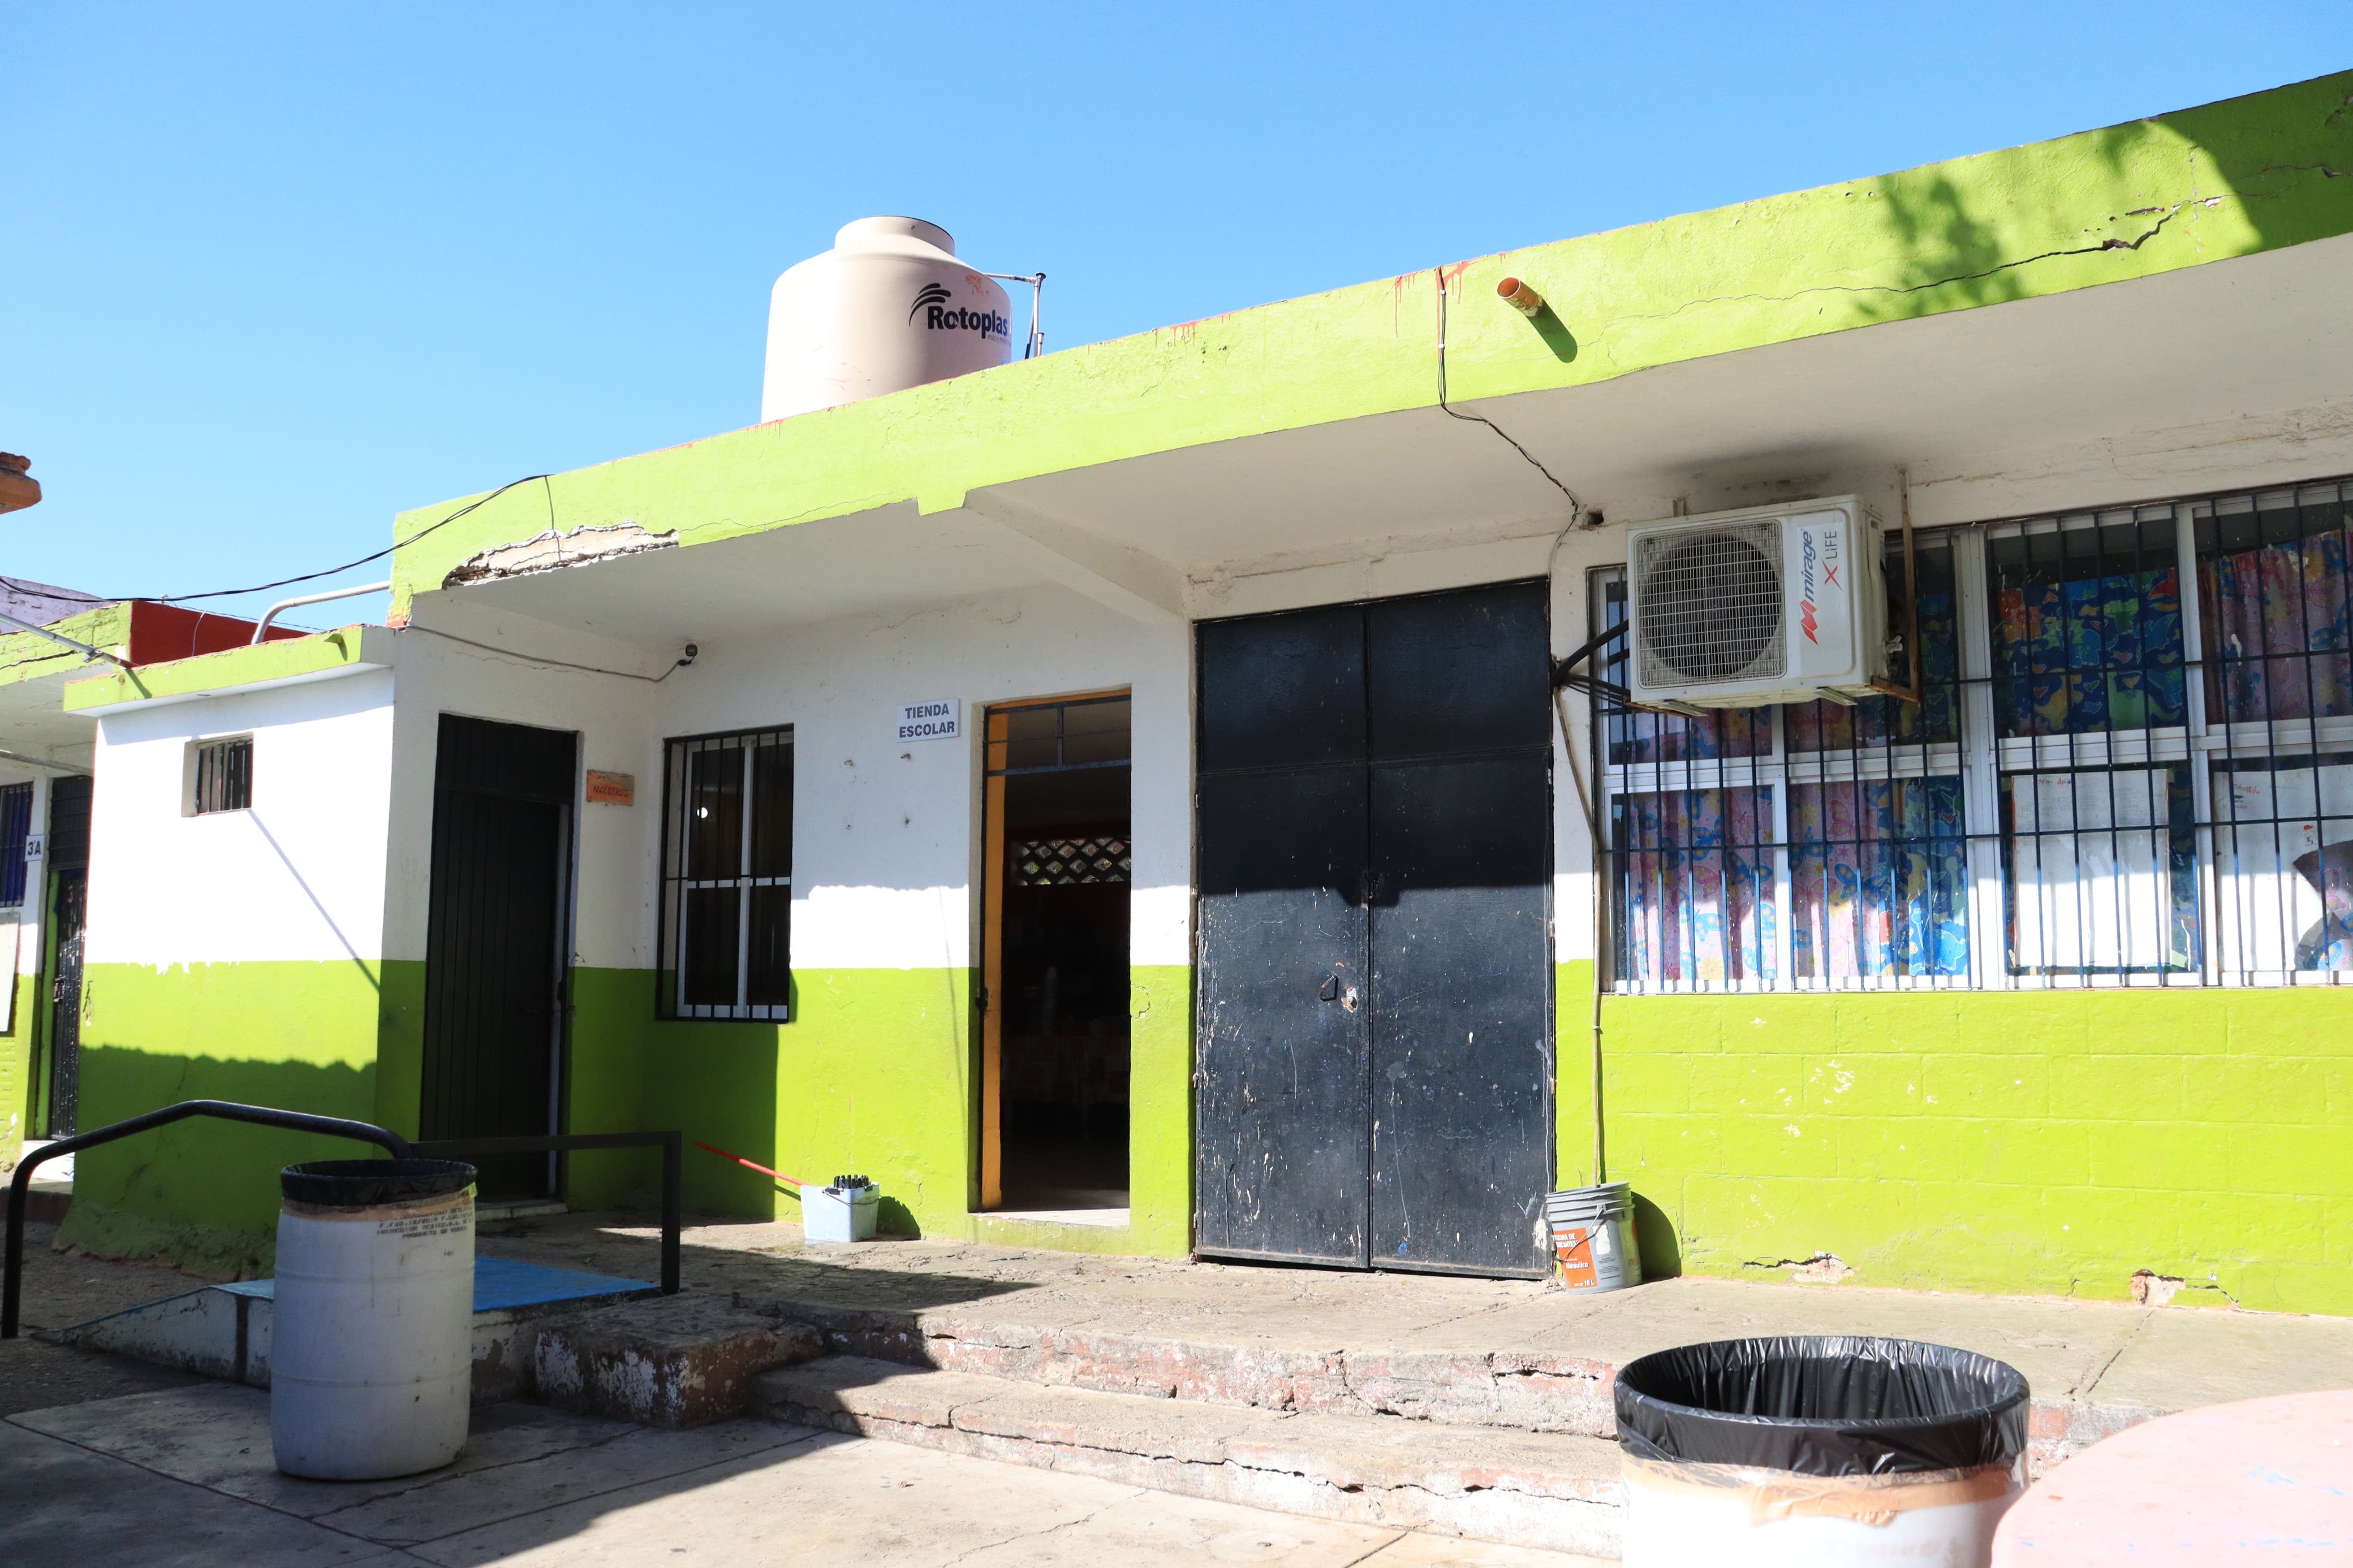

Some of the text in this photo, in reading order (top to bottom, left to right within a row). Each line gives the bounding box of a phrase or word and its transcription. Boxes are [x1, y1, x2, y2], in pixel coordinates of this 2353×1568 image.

[928, 306, 1008, 339] Rotoplas
[1801, 530, 1816, 603] mirage
[1821, 559, 1843, 590] X
[905, 703, 949, 719] TIENDA
[899, 721, 955, 738] ESCOLAR
